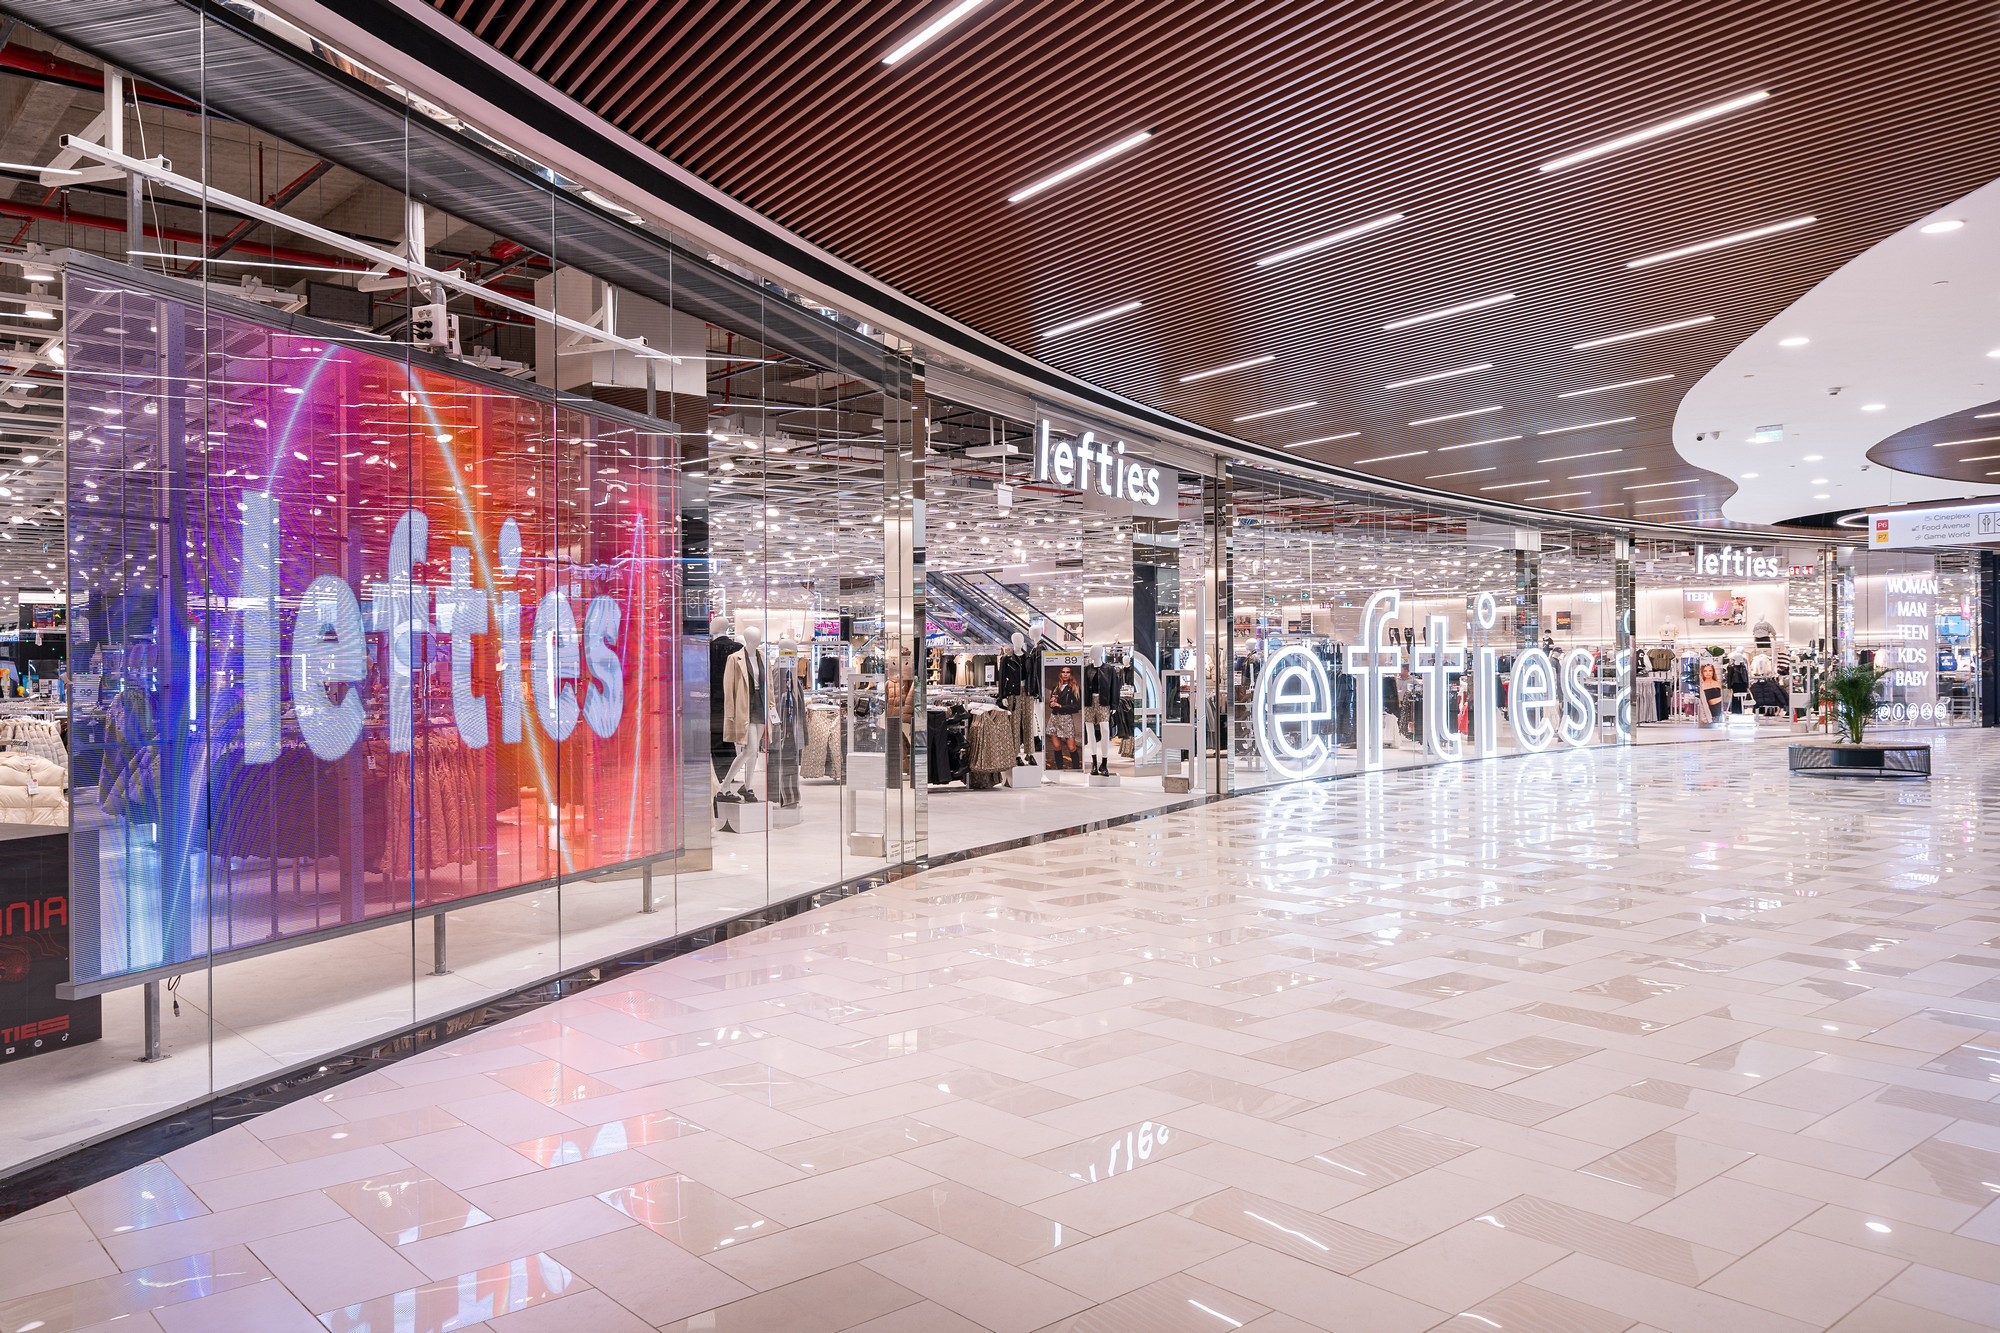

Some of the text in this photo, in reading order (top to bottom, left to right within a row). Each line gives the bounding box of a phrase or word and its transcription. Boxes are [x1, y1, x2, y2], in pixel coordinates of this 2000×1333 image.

[1040, 418, 1160, 506] lefties
[1933, 513, 1971, 521] Cineplexx
[1942, 522, 1971, 530] Avenue
[1947, 531, 1971, 539] World
[1696, 545, 1779, 578] lefties
[1886, 578, 1938, 595] WOMAN
[1684, 592, 1714, 602] TEEN
[1897, 600, 1927, 618] MAN
[241, 489, 624, 764] lefties
[1896, 624, 1929, 641] TEEN
[1054, 656, 1078, 665] 89
[1898, 648, 1927, 664] KIDS
[1895, 670, 1929, 687] BABY
[0, 896, 67, 936] NIA
[1, 1014, 70, 1044] TIES
